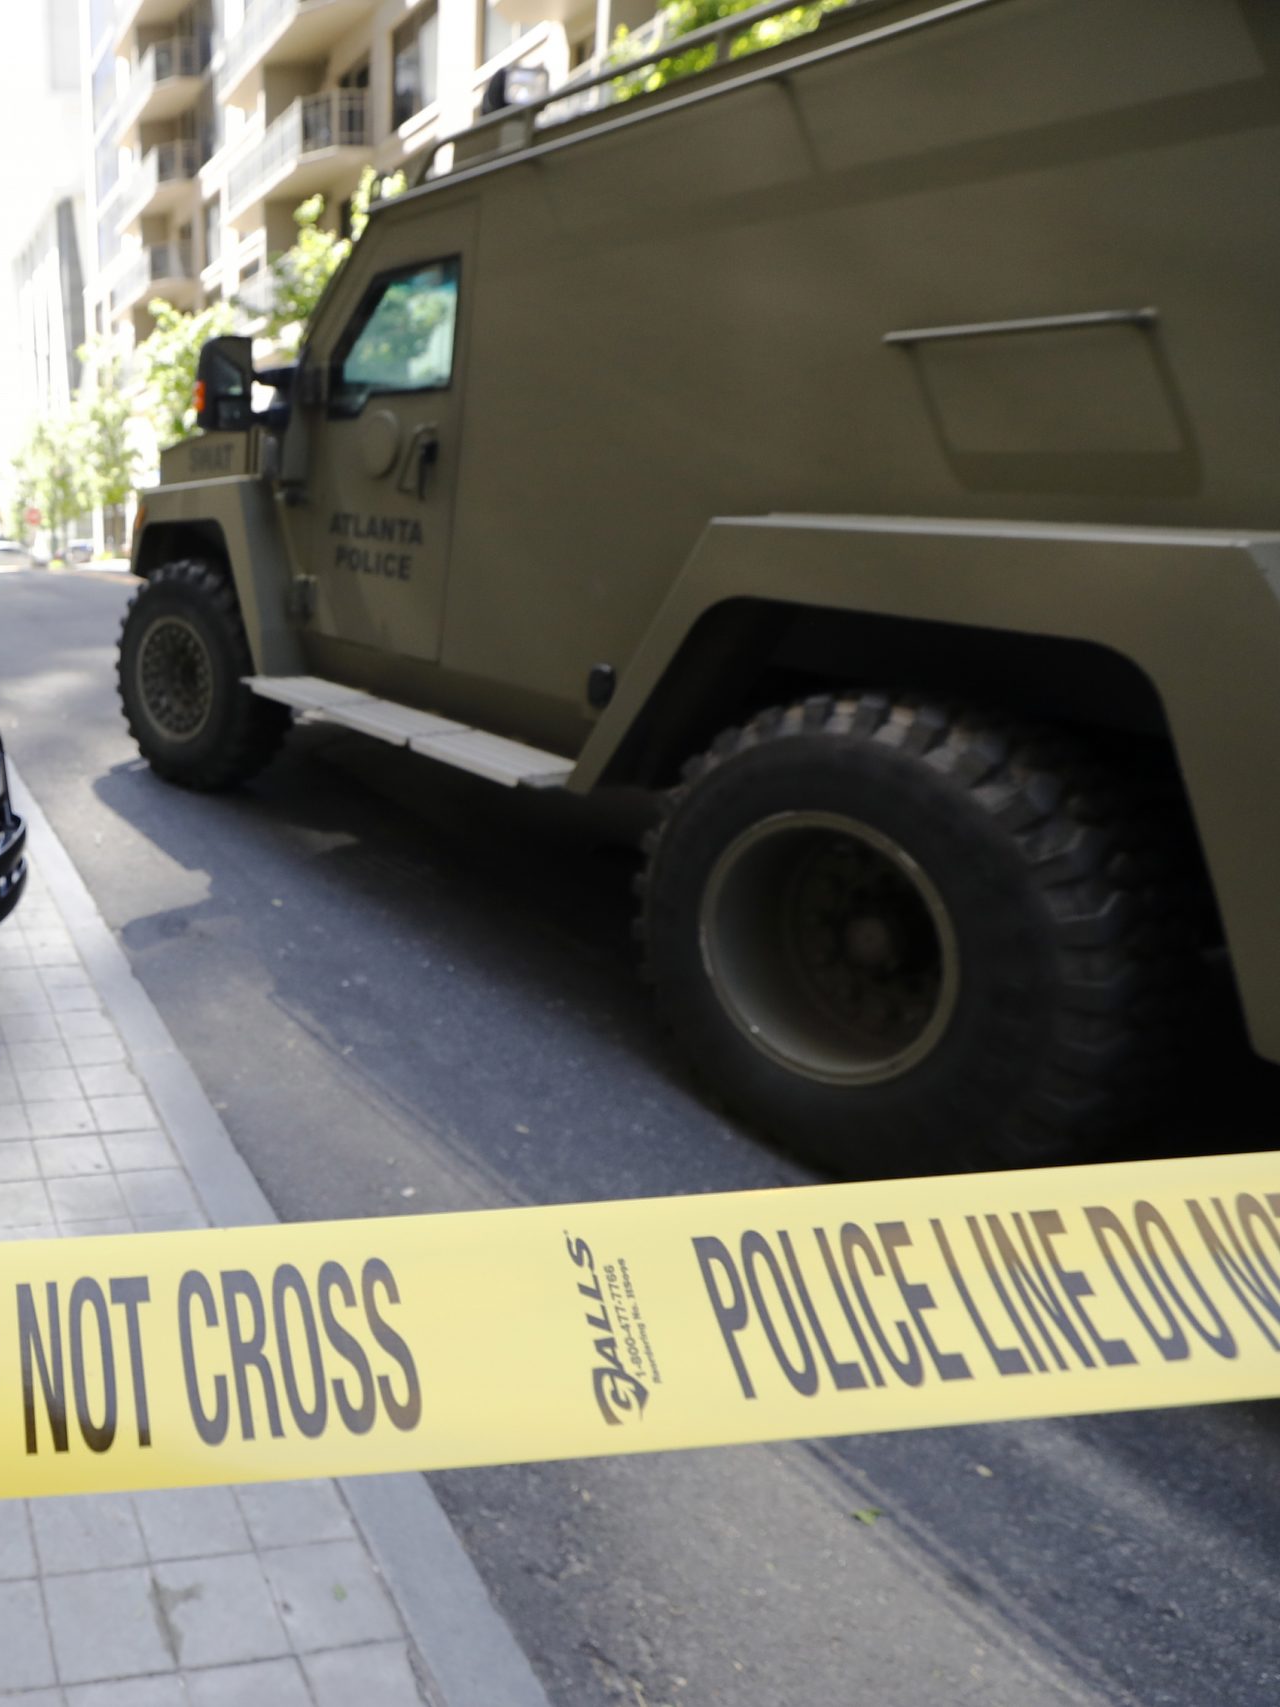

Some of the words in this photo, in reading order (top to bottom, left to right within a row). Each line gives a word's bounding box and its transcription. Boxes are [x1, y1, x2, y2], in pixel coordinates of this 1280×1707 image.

[329, 512, 424, 546] ATLANTA
[334, 545, 414, 581] POLICE
[16, 1275, 151, 1455] NOT
[177, 1257, 422, 1446] CROSS
[604, 1264, 646, 1377] 1-800-477-7766
[691, 1221, 974, 1400] POLICE
[929, 1209, 1139, 1377] LINE
[1083, 1199, 1238, 1362] DO
